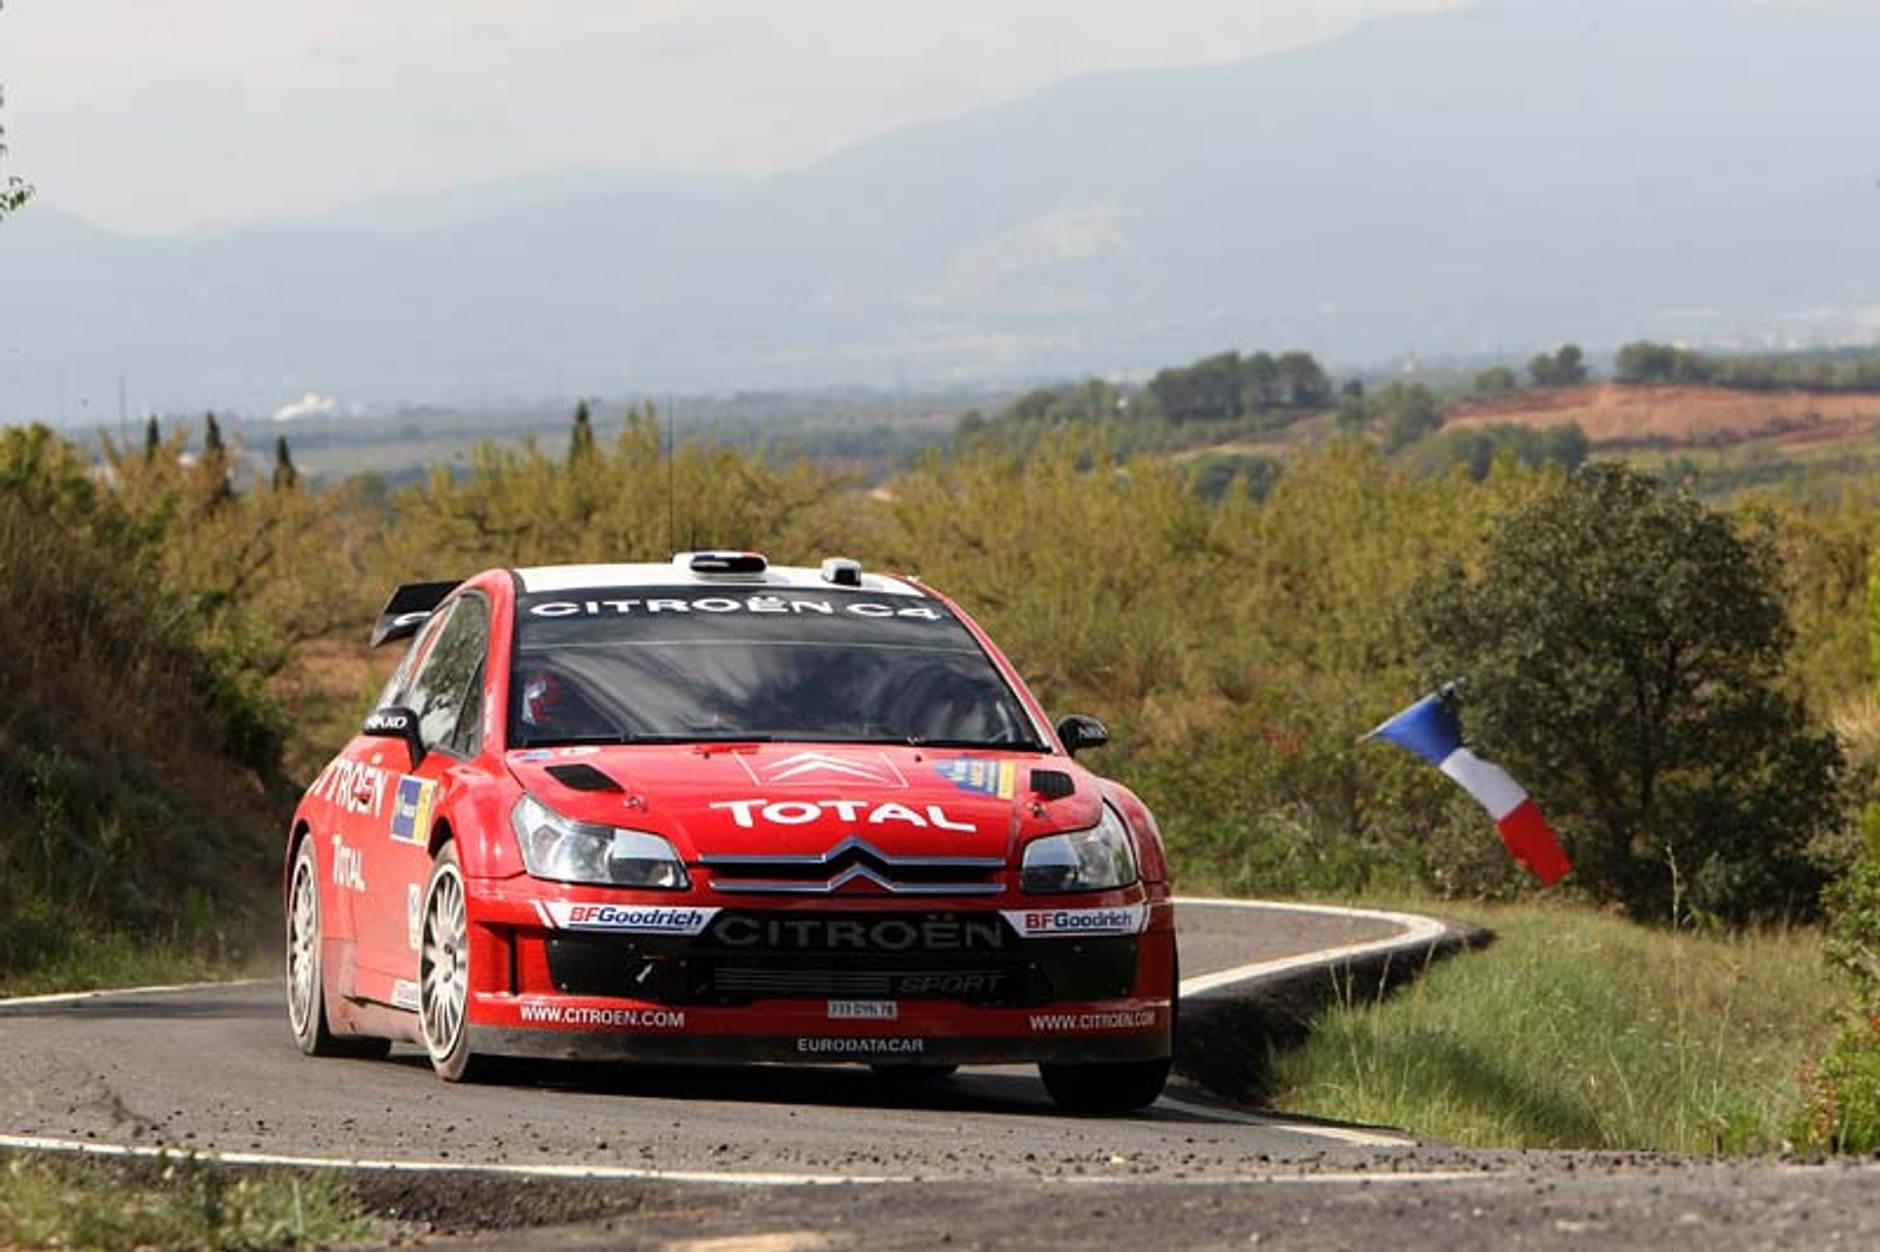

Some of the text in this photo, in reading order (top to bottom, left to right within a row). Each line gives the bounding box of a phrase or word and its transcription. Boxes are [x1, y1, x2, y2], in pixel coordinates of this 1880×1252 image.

[529, 597, 941, 621] CITROËN C4
[709, 799, 977, 832] TOTAL
[568, 906, 703, 927] BFGoodrich
[1025, 910, 1132, 929] BFGoodrich
[713, 913, 1003, 948] CITROËN
[899, 974, 1003, 995] SPORT
[520, 1005, 686, 1028] WWW.CITROEN.COM
[1028, 1010, 1155, 1031] WWW.CITROEN.COM
[796, 1038, 923, 1053] EURODATACAR
